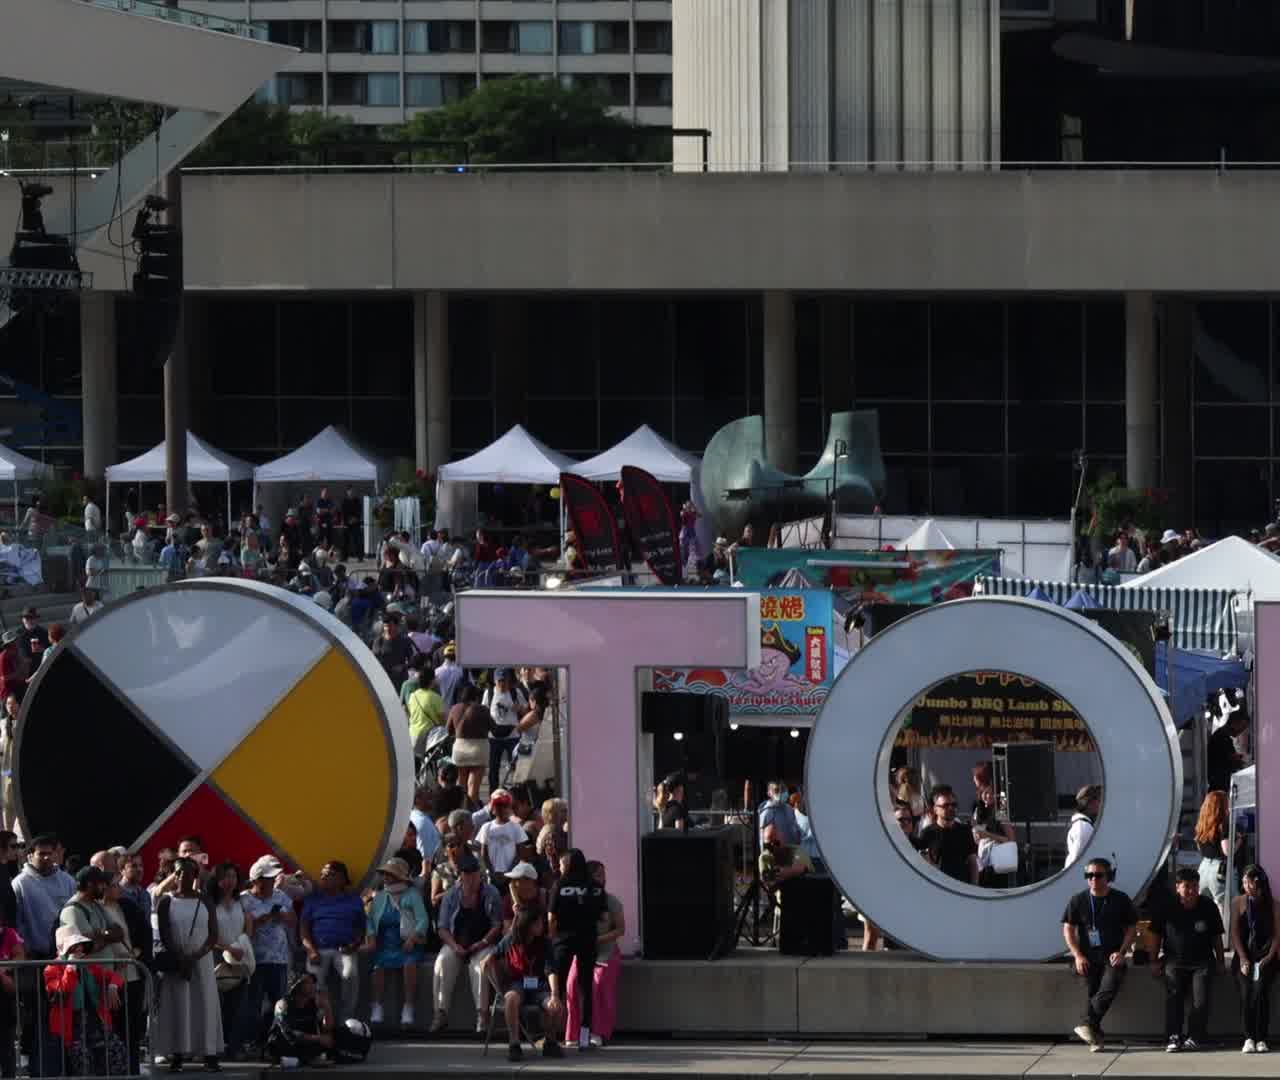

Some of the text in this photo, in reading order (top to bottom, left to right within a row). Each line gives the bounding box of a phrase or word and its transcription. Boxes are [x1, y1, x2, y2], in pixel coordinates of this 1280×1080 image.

[917, 695, 967, 709] Jumbo
[972, 698, 1005, 711] BBQ
[1008, 699, 1049, 711] Lamb
